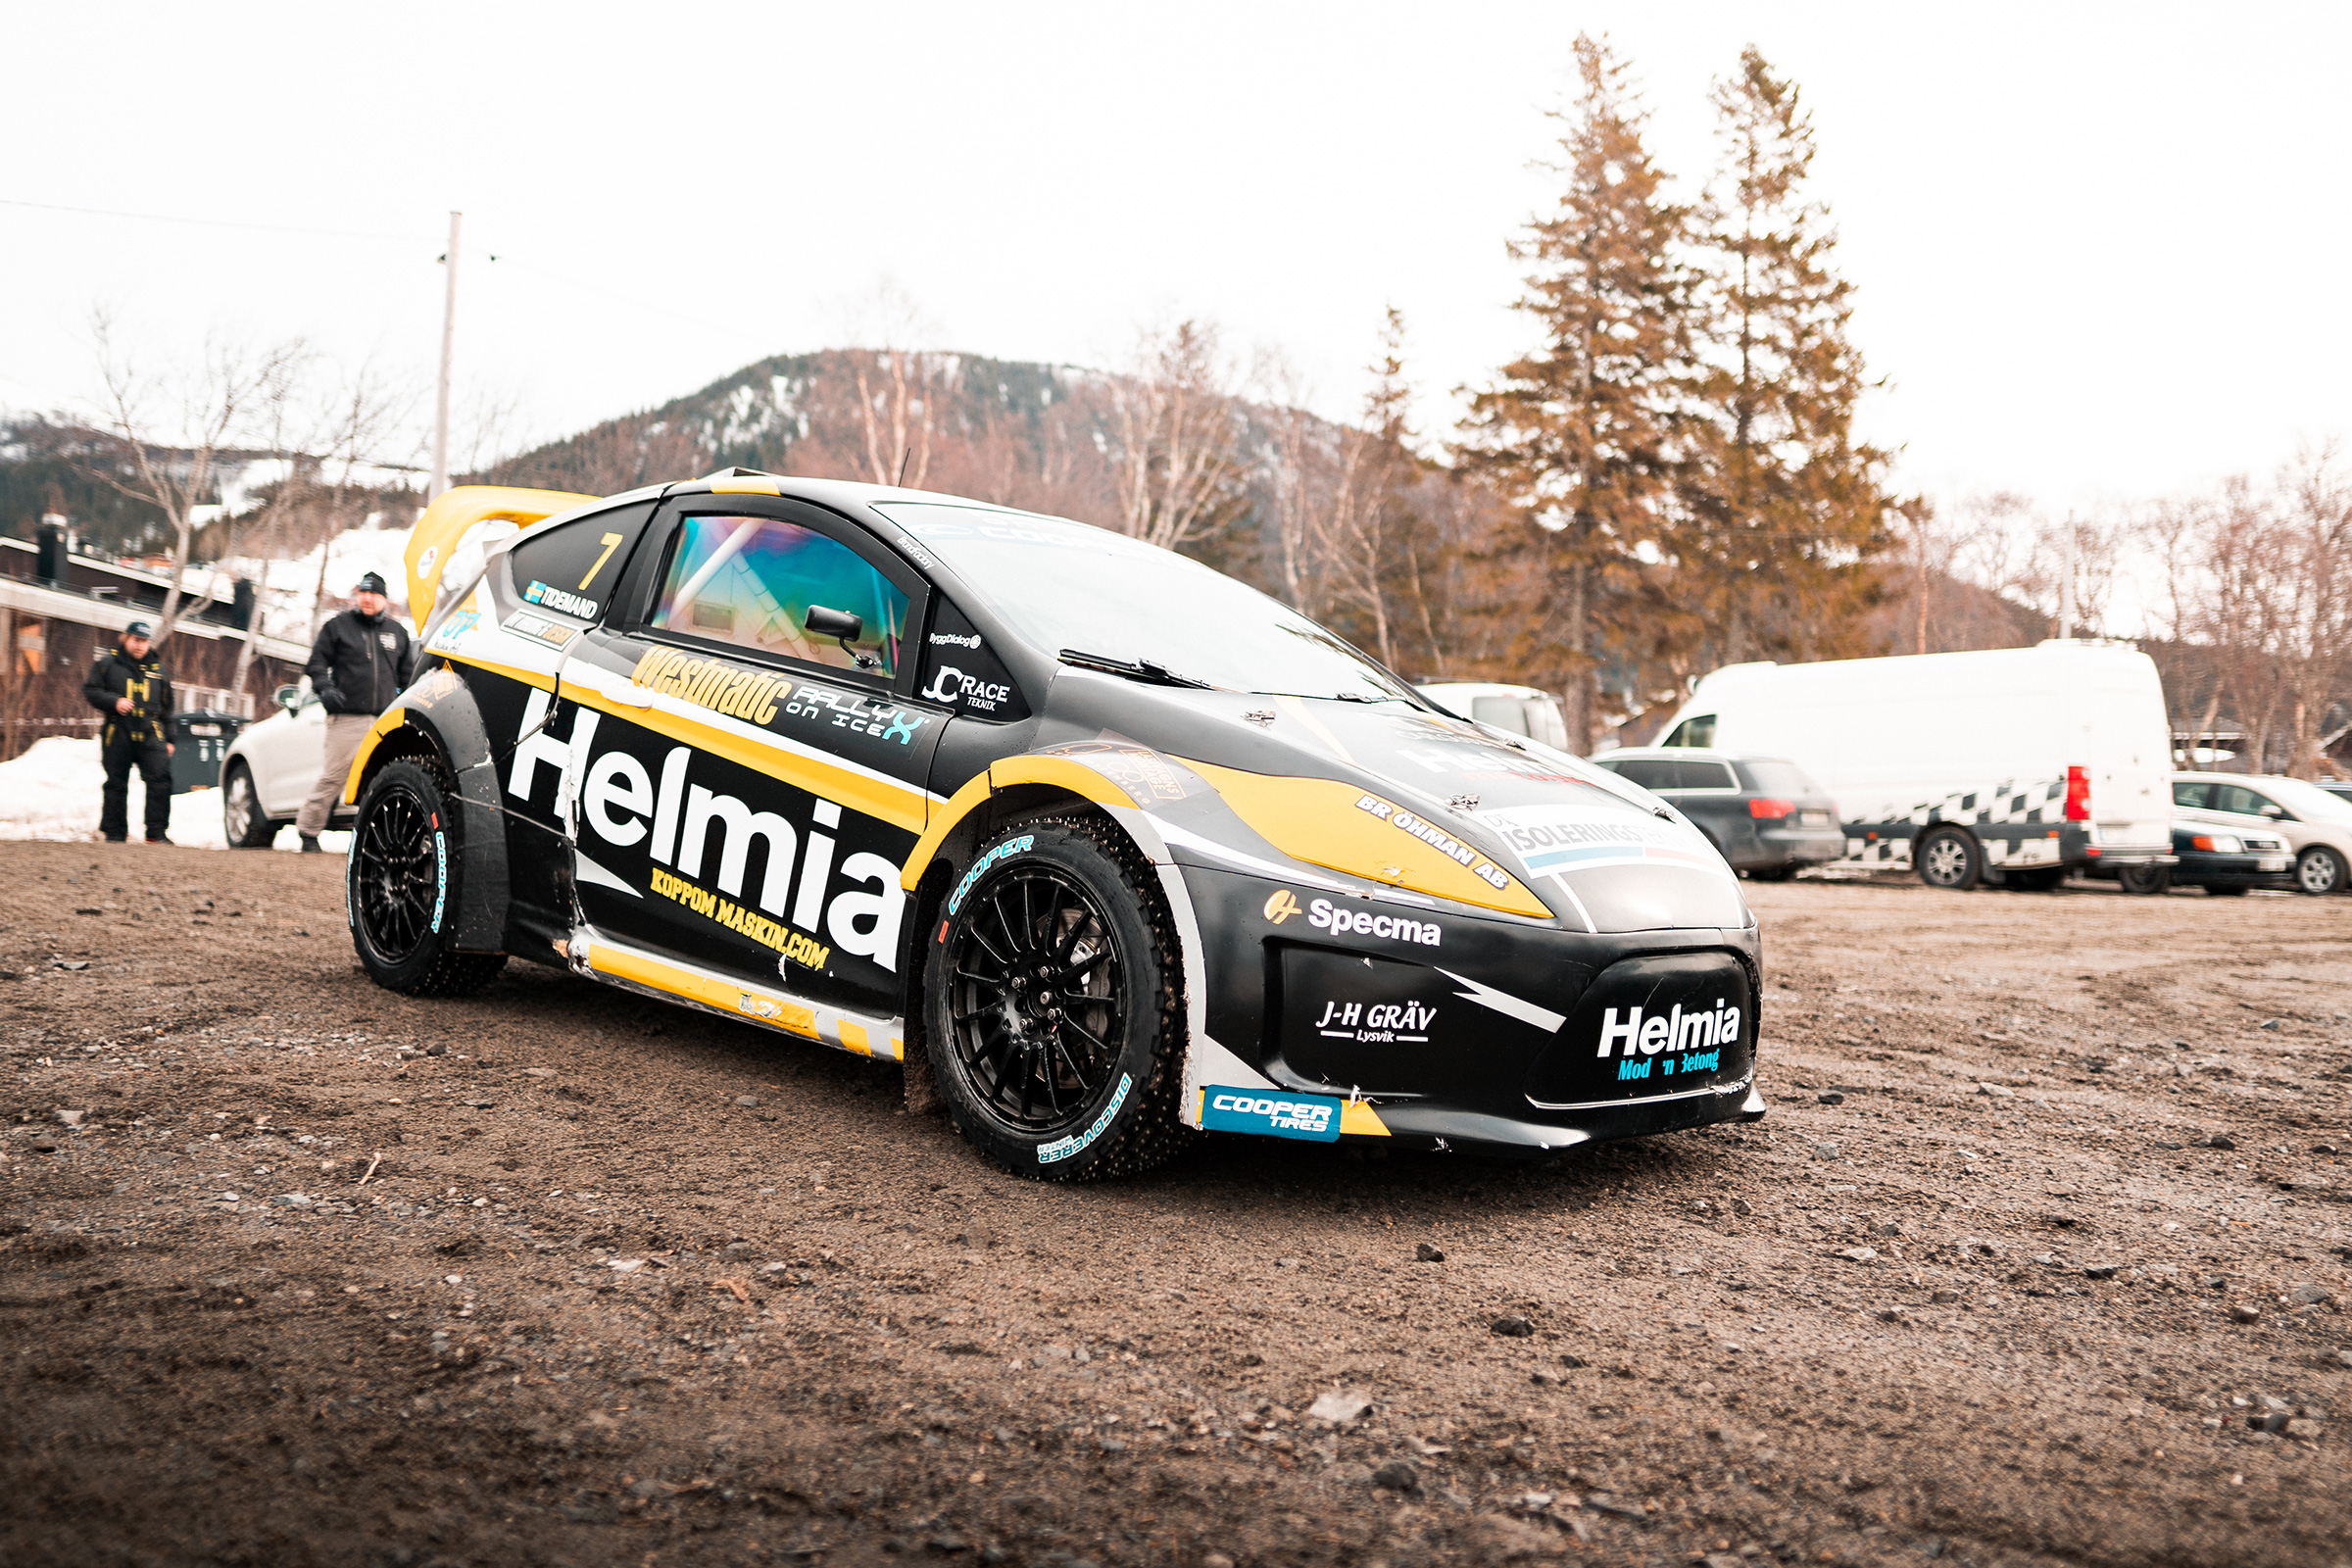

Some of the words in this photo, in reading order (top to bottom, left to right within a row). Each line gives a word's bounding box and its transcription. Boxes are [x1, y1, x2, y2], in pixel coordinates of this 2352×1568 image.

[578, 532, 623, 590] 7
[540, 586, 598, 619] TIDEMAND
[632, 644, 792, 725] Westmatic
[959, 674, 1010, 703] RACE
[966, 696, 997, 711] TEKNIK
[508, 686, 906, 973] Helmia
[1355, 795, 1393, 821] BR
[1392, 810, 1477, 868] ÖHMAN
[1473, 862, 1510, 891] AB
[948, 834, 1035, 916] COOPER
[650, 867, 716, 918] KOPPOM
[714, 898, 831, 970] MASKIN.COM
[1308, 899, 1442, 947] Specma
[1315, 1001, 1362, 1028] J-H
[1366, 1000, 1438, 1031] GRÄV
[1356, 1029, 1395, 1043] Lysvik
[1596, 998, 1740, 1057] Helmia
[1038, 1072, 1133, 1163] DISCOVERER
[1212, 1095, 1333, 1121] COOPER
[1269, 1115, 1329, 1132] TIRES
